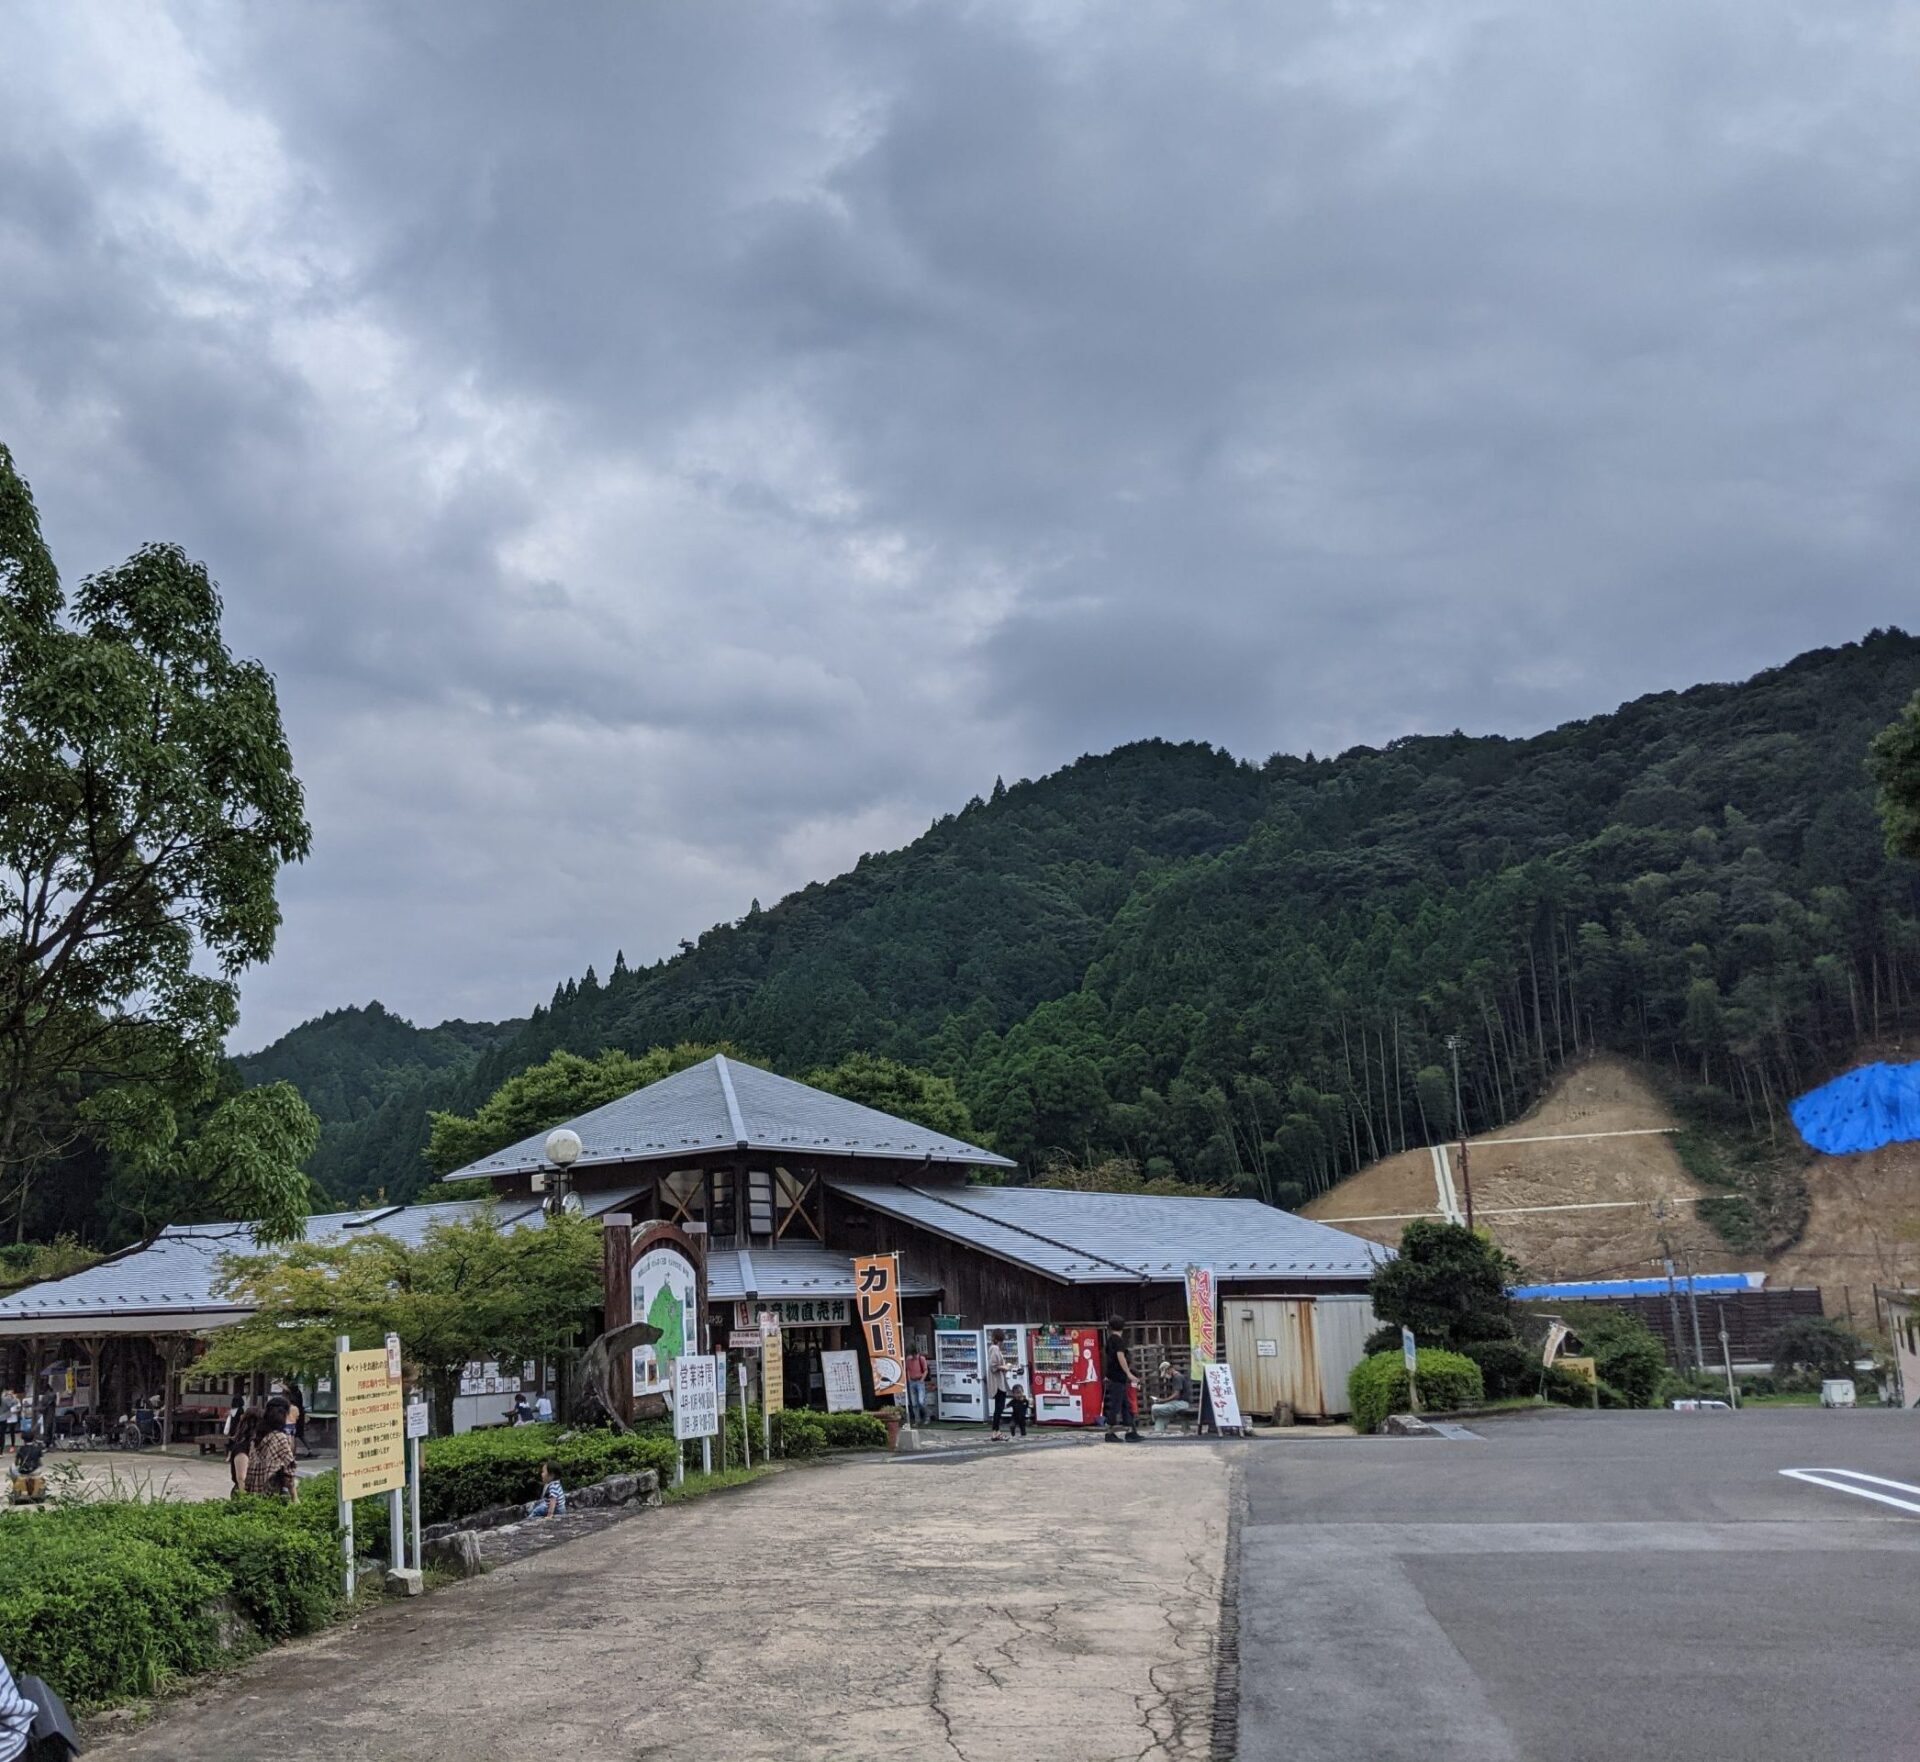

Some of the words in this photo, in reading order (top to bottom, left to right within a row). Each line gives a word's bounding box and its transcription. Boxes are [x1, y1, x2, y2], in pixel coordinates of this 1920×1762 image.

[859, 1265, 891, 1351] カレー
[680, 1363, 714, 1390] 営業時間
